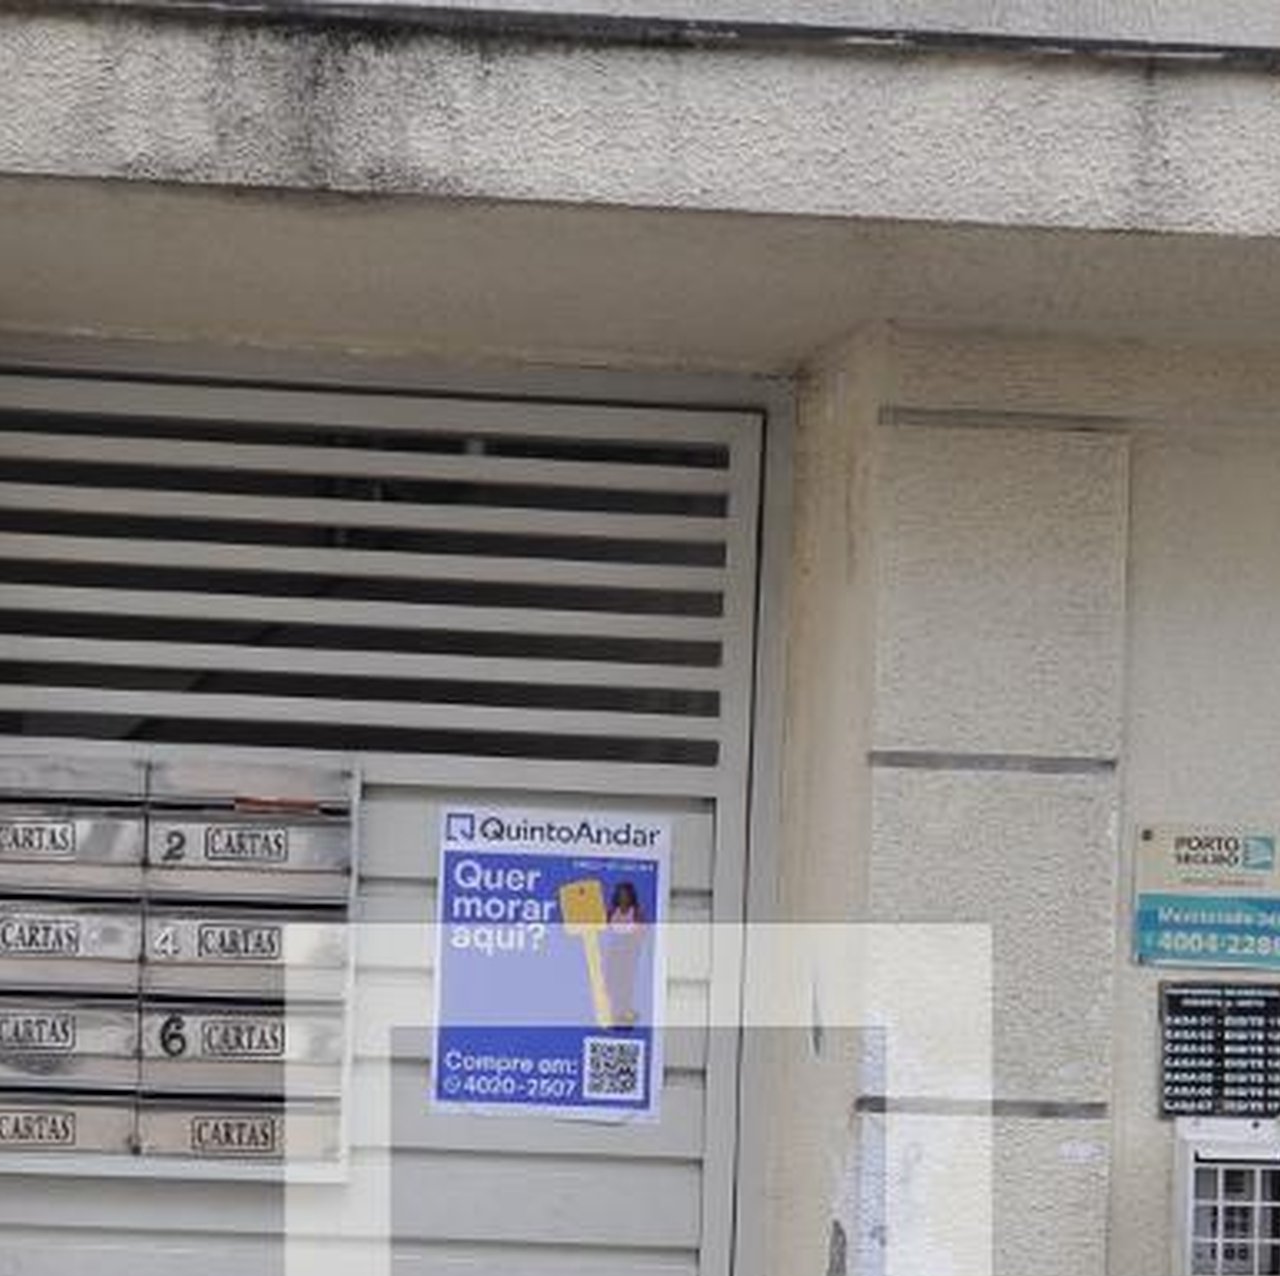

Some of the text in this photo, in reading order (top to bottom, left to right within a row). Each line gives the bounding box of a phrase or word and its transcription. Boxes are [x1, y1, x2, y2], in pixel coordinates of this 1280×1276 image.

[162, 830, 283, 860] 2 CARTAS
[479, 816, 661, 847] QuintoAndar
[1175, 836, 1239, 851] PORTO
[455, 860, 541, 891] Quer
[452, 895, 556, 921] morar
[1, 921, 76, 949] CARTAS
[154, 926, 276, 955] 4 CARTAS
[451, 924, 545, 954] aqui?
[161, 1016, 279, 1057] 6 CARTAS
[445, 1049, 578, 1075] Compre em:
[197, 1121, 269, 1146] CARTAS
